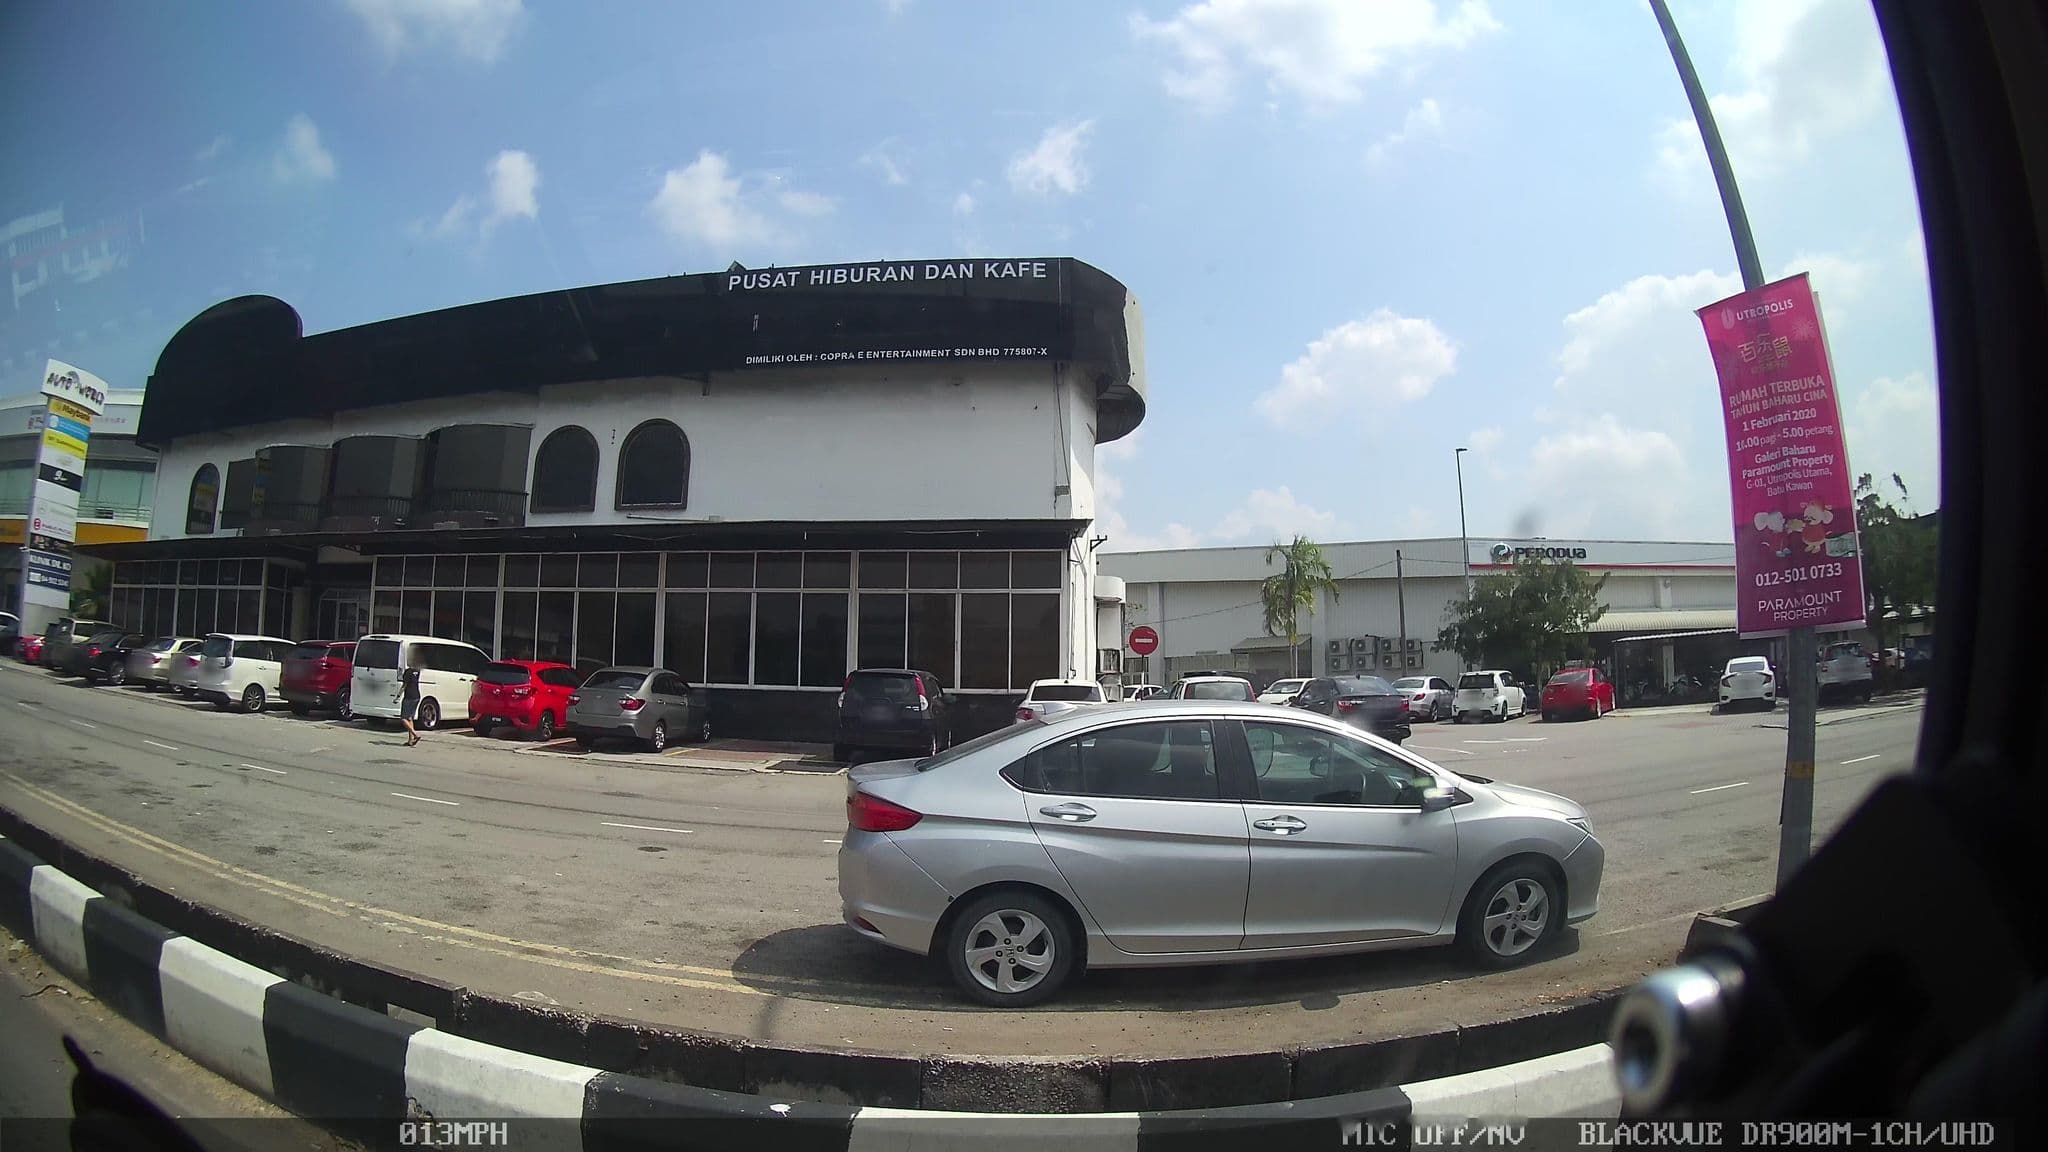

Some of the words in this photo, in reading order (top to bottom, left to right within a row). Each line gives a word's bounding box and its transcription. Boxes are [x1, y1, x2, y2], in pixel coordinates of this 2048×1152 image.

[728, 271, 800, 291] PUSAT
[810, 265, 914, 285] HIBURAN
[925, 263, 973, 280] DAN
[984, 262, 1047, 278] KAFE
[1736, 299, 1794, 321] UTROPOLIS
[746, 355, 784, 365] DIMILIKI
[786, 353, 813, 362] OLEH
[820, 352, 855, 361] COPRA
[858, 351, 864, 359] E
[866, 349, 951, 359] ENTERTAINMENT
[954, 348, 976, 356] SDN
[978, 348, 1000, 356] BHD
[1003, 347, 1048, 356] 775807-X
[47, 372, 73, 391] AUTO
[1729, 385, 1768, 407] RUMAH
[1770, 375, 1825, 394] TERBUKA
[62, 404, 91, 422] Maybank
[1730, 402, 1761, 419] TAHUN
[1762, 393, 1801, 410] BAHARU
[1804, 389, 1828, 402] CINA
[1742, 421, 1749, 431] 1
[1751, 410, 1792, 430] Februari
[1793, 408, 1817, 421] 2020
[1782, 427, 1804, 438] 5.00
[1805, 424, 1834, 438] petang
[1754, 448, 1782, 464] Galeri
[1782, 445, 1816, 456] Baharu
[1742, 458, 1791, 479] Paramount
[1792, 453, 1834, 468] Property
[1803, 467, 1833, 478] Utama,
[1767, 485, 1785, 497] Batu
[1785, 481, 1813, 493] Kawan
[1755, 566, 1808, 587] 012-501
[1810, 562, 1842, 579] 0733
[1758, 590, 1843, 612] PARAMOUNT
[1773, 606, 1828, 621] PROPERTY
